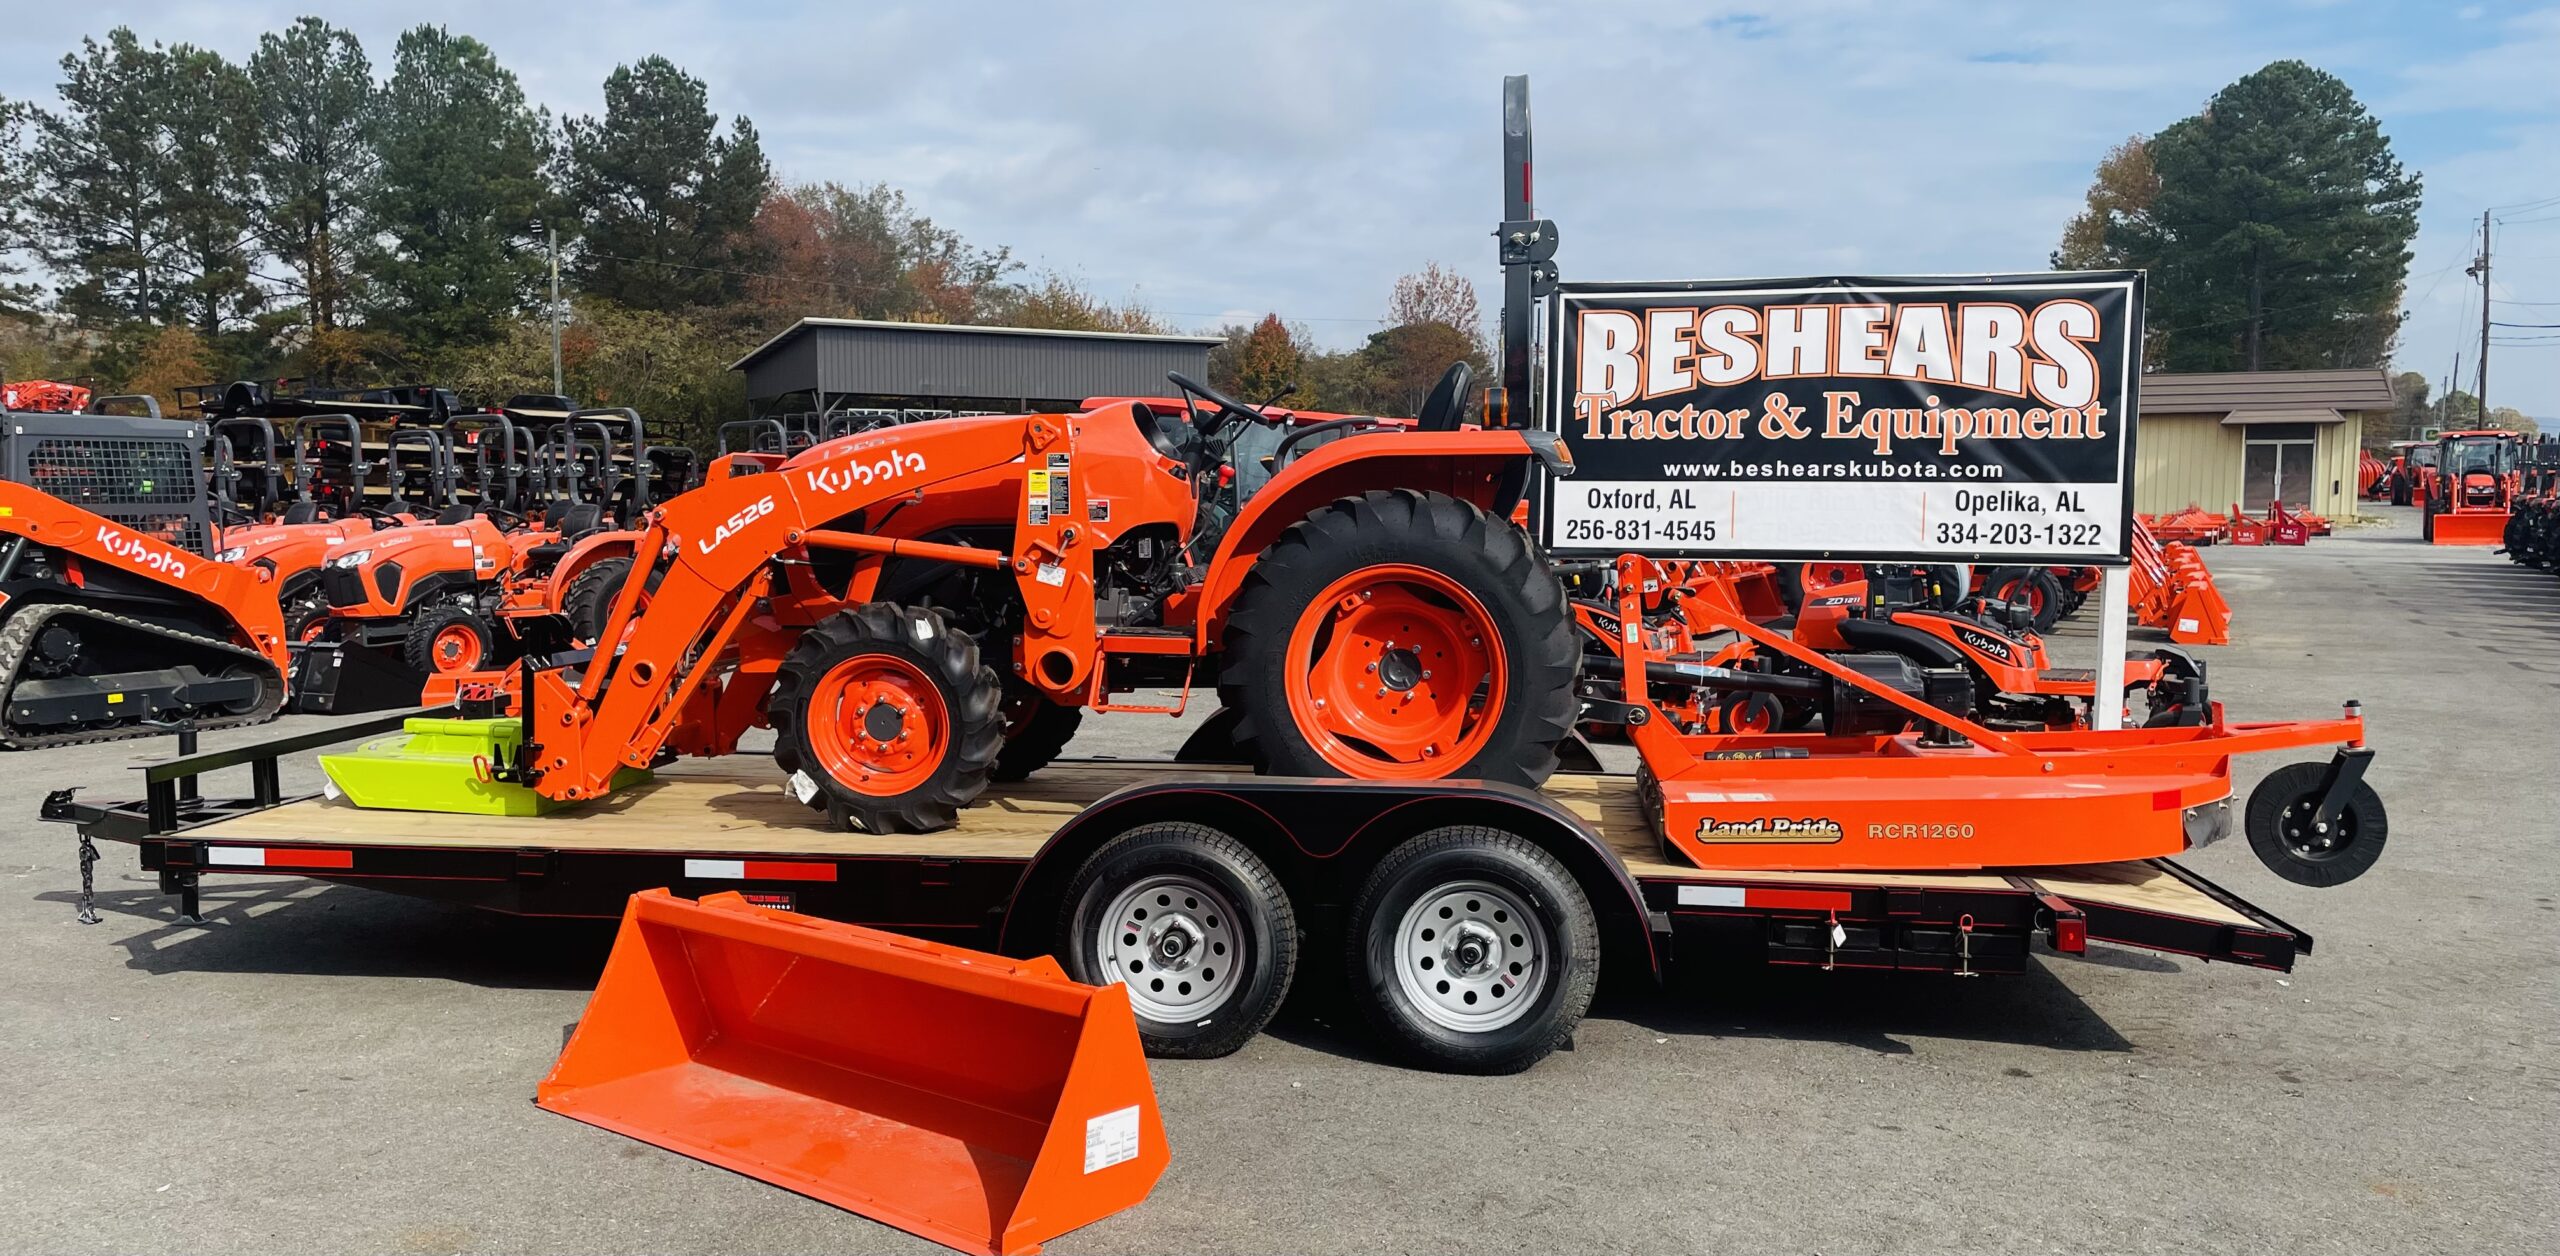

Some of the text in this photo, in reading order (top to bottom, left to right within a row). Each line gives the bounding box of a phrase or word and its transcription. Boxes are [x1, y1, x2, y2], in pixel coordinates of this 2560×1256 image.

[1575, 299, 2100, 420] BESHEARS
[1573, 391, 2108, 456] Tractor & Equipment
[806, 448, 927, 495] Kubota
[1663, 460, 2004, 478] www.beshearskubota.com
[1587, 488, 1697, 513] Oxford, AL
[1955, 489, 2086, 517] Opelika, AL
[698, 494, 776, 555] LA526
[1566, 519, 1717, 541] 256-831-4545
[1936, 522, 2102, 546] 334-203-1322
[97, 525, 186, 579] Kubota
[1598, 616, 1620, 633] Kub
[1964, 631, 2008, 659] Kubota
[1700, 818, 1840, 837] Land Pride
[1867, 823, 1976, 839] RCR1260
